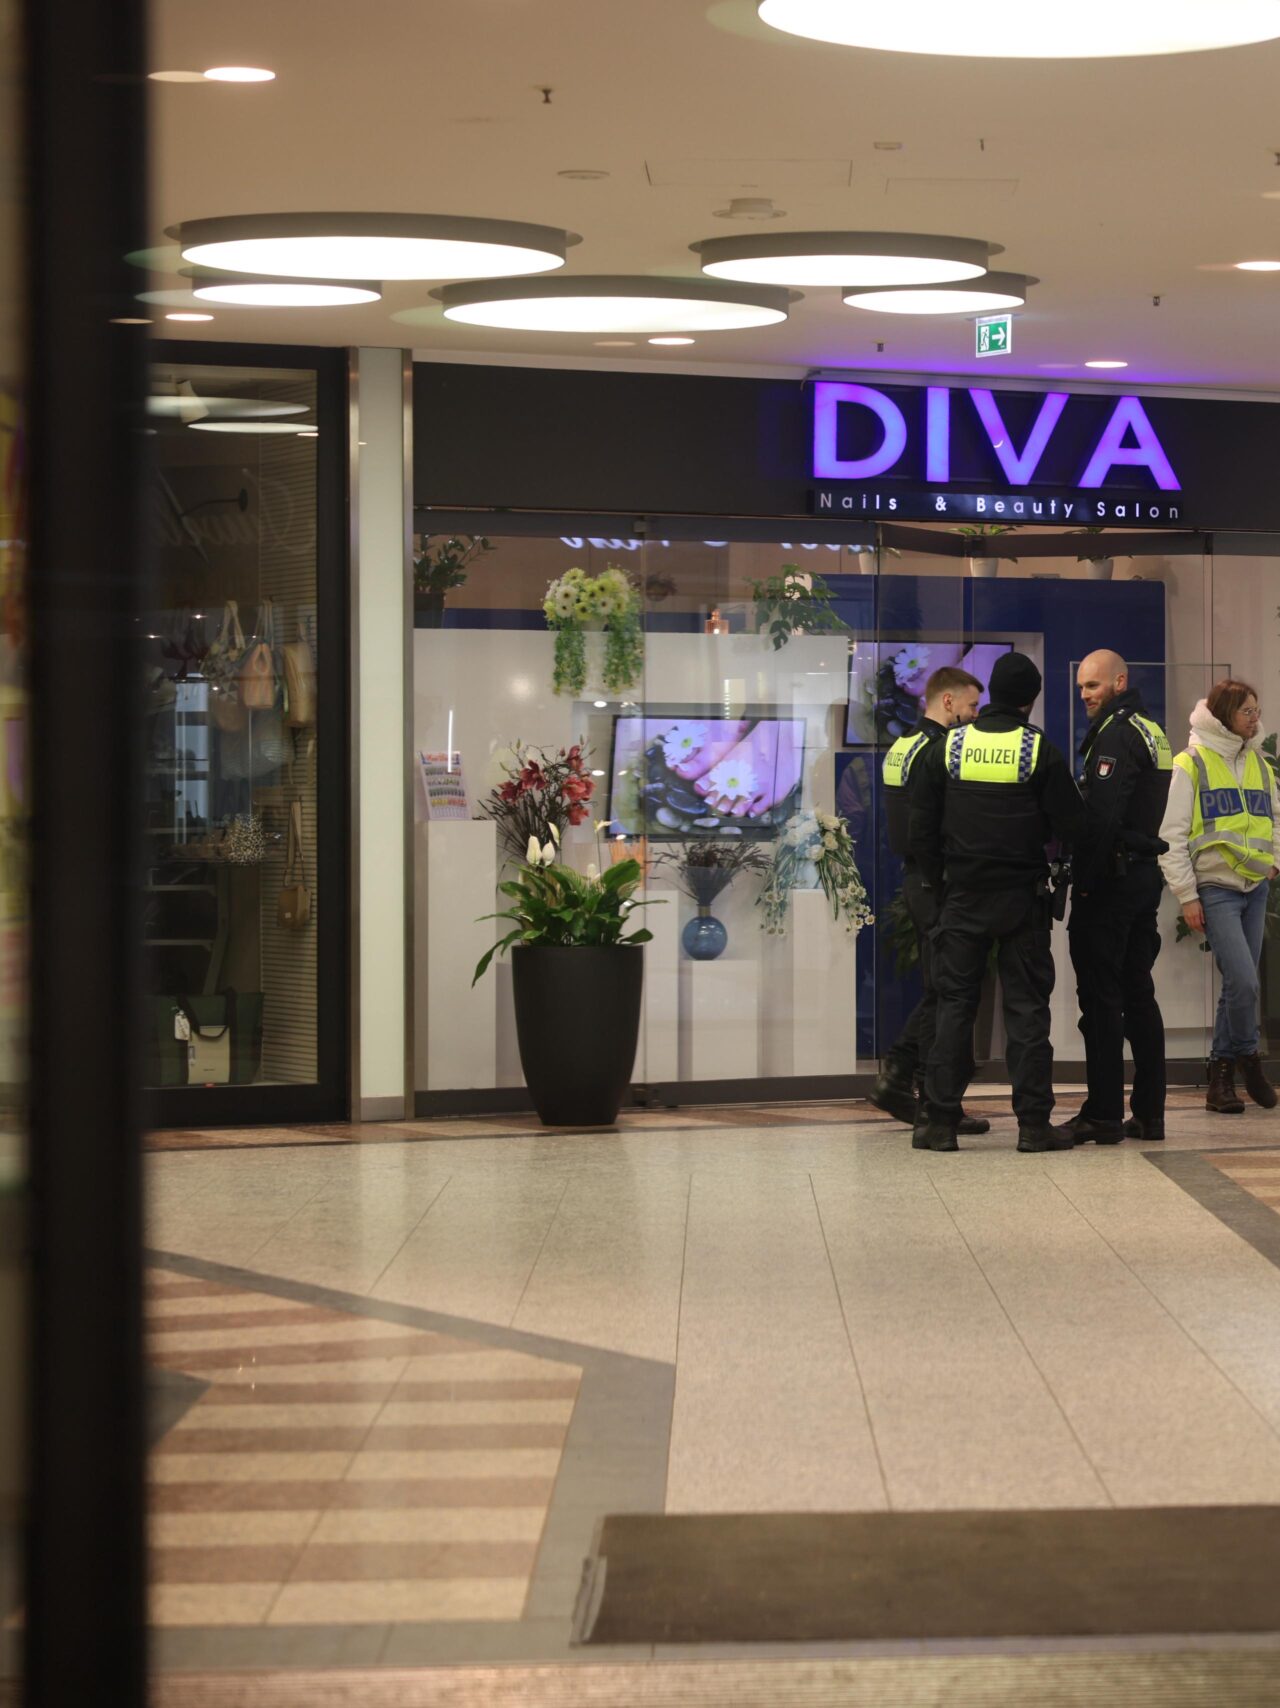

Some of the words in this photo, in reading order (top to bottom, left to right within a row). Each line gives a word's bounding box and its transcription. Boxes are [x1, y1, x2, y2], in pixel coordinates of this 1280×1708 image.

[813, 381, 1182, 491] DIVA
[819, 493, 898, 511] Nails
[935, 496, 948, 513] &
[976, 497, 1074, 519] Beauty
[1096, 501, 1179, 520] Salon
[965, 747, 1016, 765] POLIZEI
